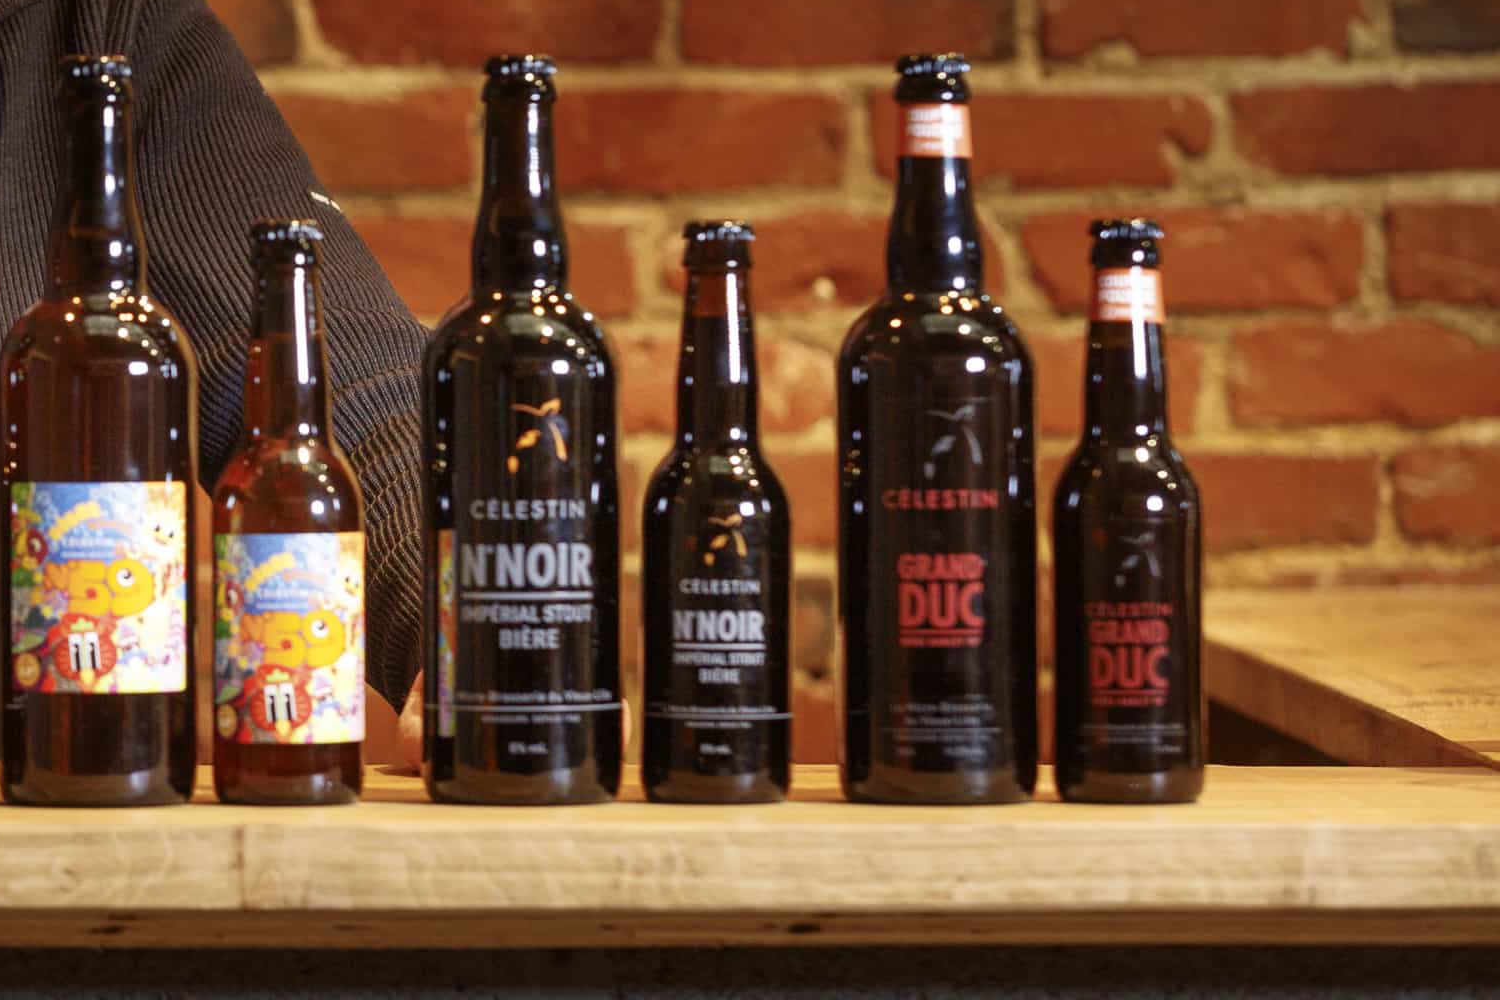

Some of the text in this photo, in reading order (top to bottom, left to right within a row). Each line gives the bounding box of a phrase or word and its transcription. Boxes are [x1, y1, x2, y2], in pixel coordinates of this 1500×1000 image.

[469, 497, 586, 520] CÉLESTIN
[460, 542, 593, 588] N'NOIR
[897, 552, 985, 580] GRAND
[542, 603, 593, 623] STOUT
[898, 581, 986, 629] DUC
[499, 625, 560, 649] BIÈRE
[672, 610, 764, 642] N'NOIR
[1090, 645, 1170, 689] DUC
